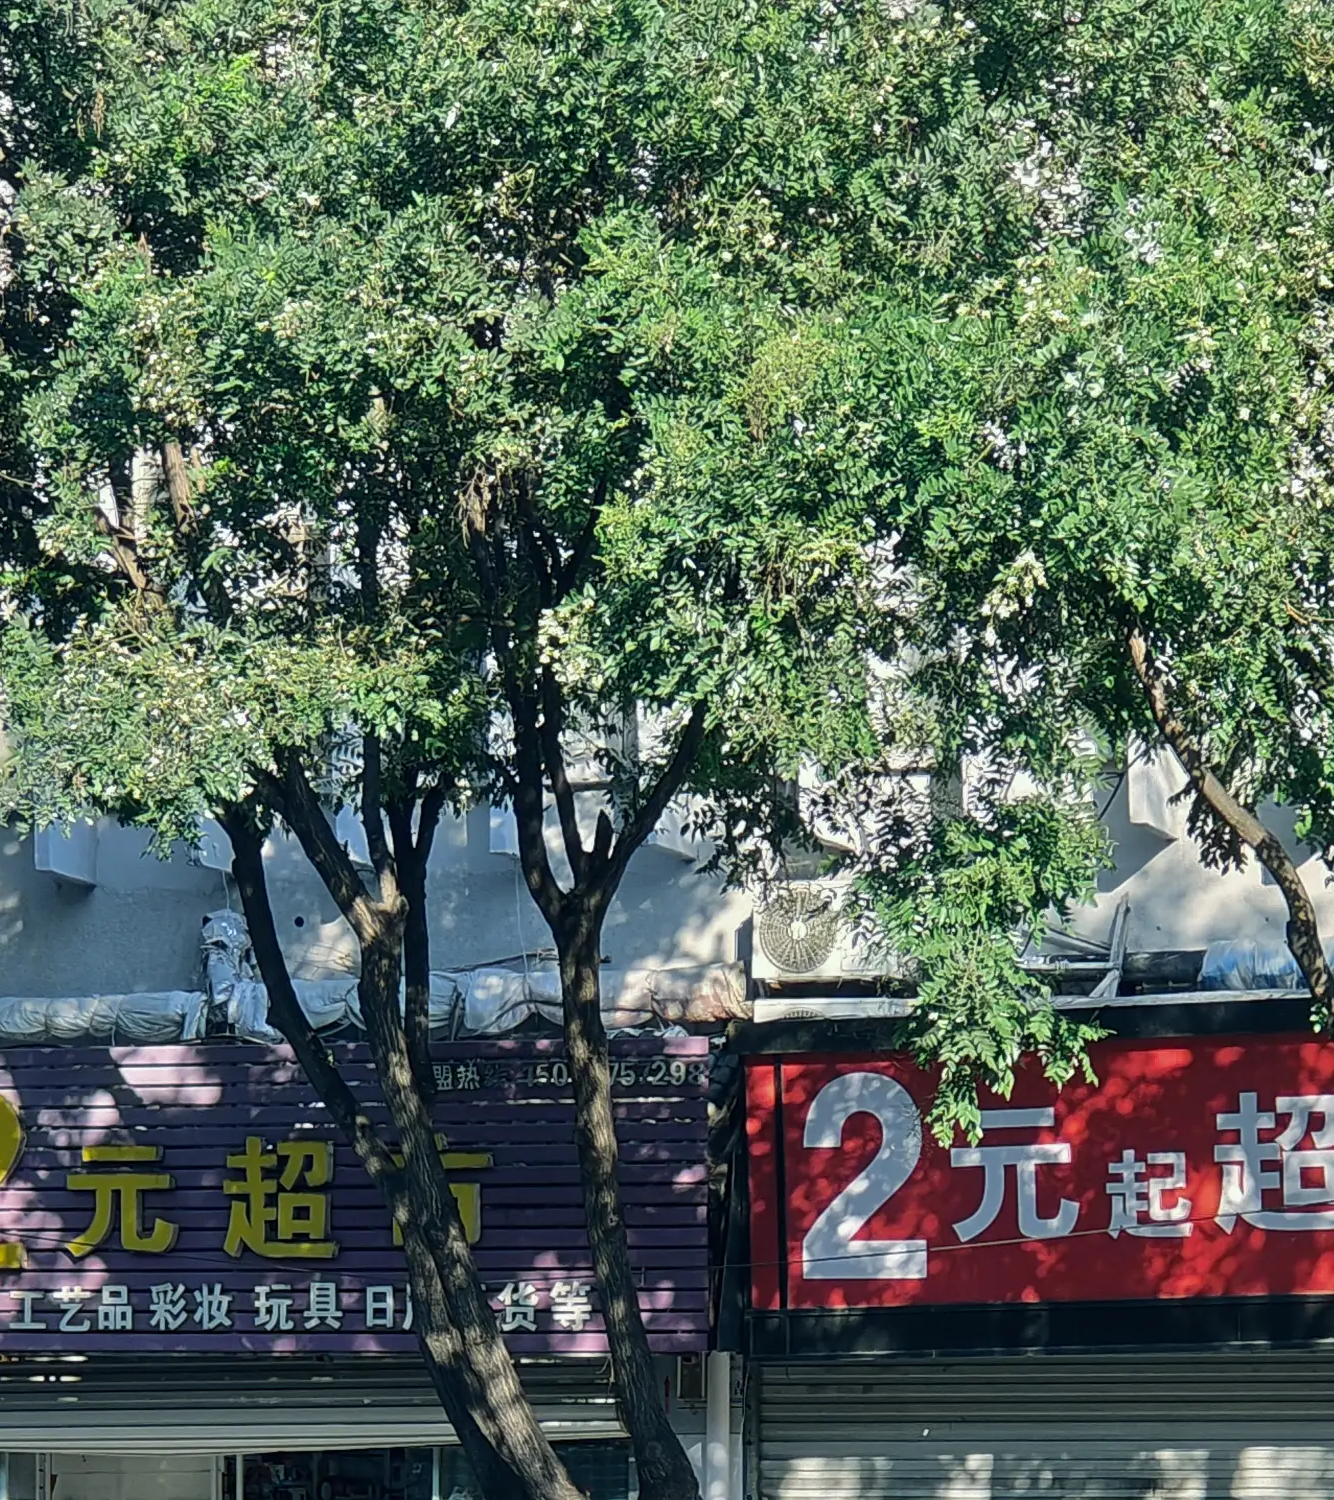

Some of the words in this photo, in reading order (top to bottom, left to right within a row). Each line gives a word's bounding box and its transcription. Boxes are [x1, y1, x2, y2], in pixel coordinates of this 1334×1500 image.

[9, 1284, 133, 1332] 工艺品
[149, 1282, 233, 1332] 彩妆
[254, 1282, 345, 1331] 玩具
[366, 1281, 592, 1332] 日货等
